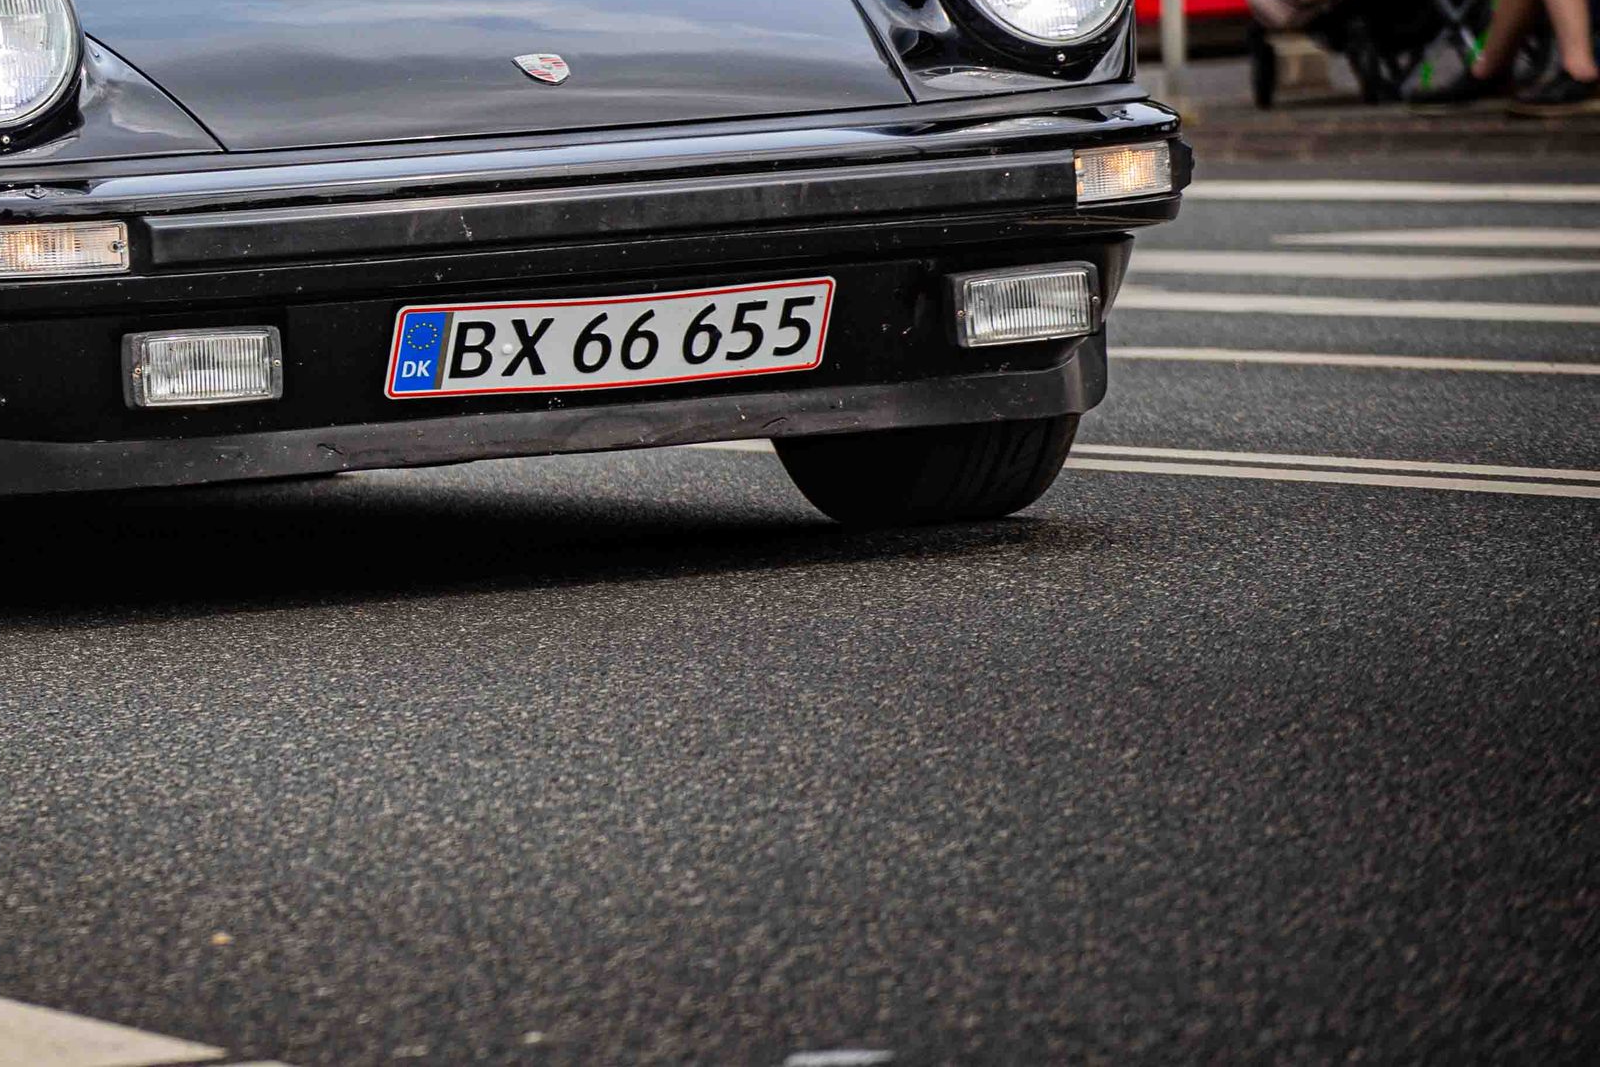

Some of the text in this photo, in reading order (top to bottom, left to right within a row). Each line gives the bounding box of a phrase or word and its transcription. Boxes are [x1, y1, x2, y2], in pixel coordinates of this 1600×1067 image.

[449, 295, 816, 379] BX 66 655
[401, 359, 431, 378] DK
